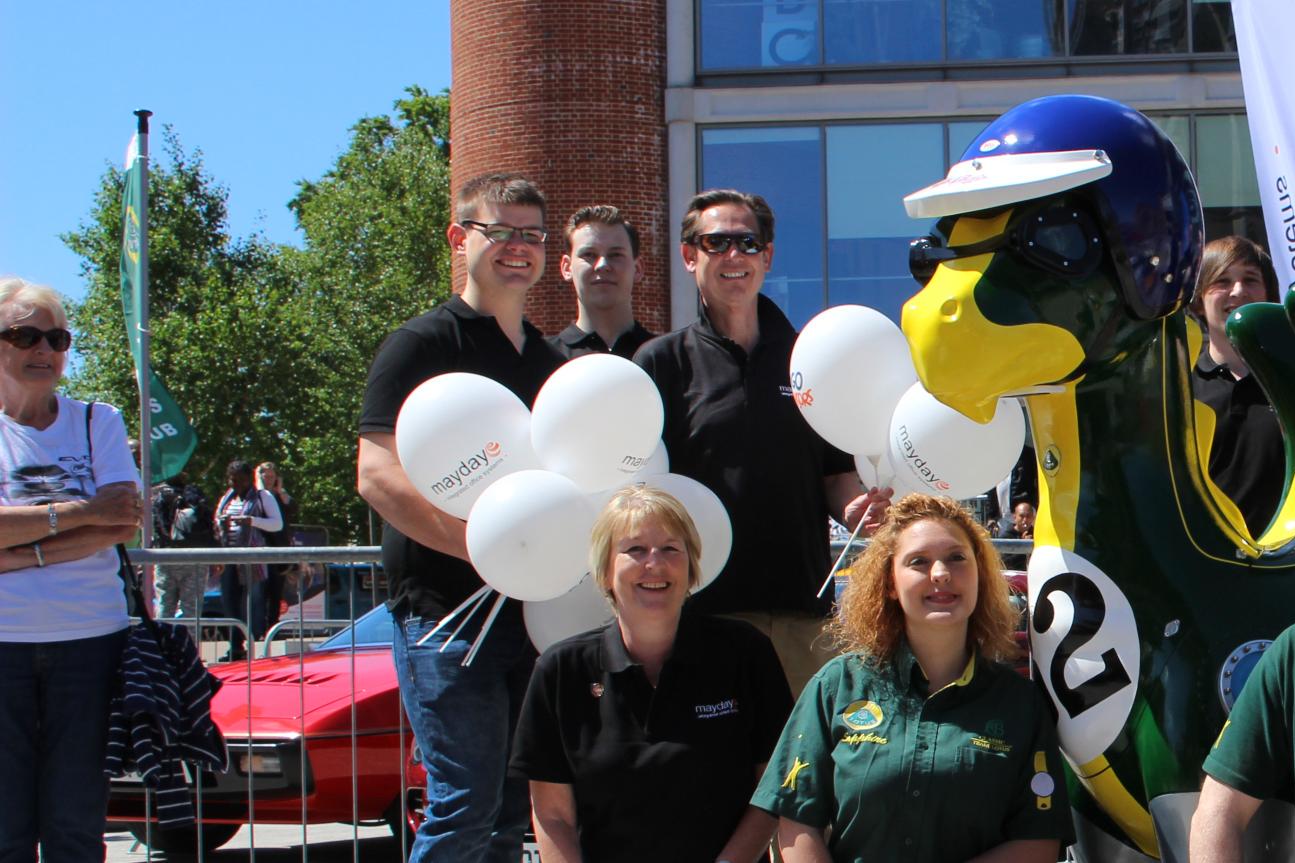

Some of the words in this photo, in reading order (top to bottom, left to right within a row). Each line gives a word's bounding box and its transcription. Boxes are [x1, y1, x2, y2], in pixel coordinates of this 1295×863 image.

[431, 449, 489, 496] mayday
[899, 424, 941, 483] mayday
[1033, 572, 1132, 719] 2
[695, 699, 734, 714] mayday
